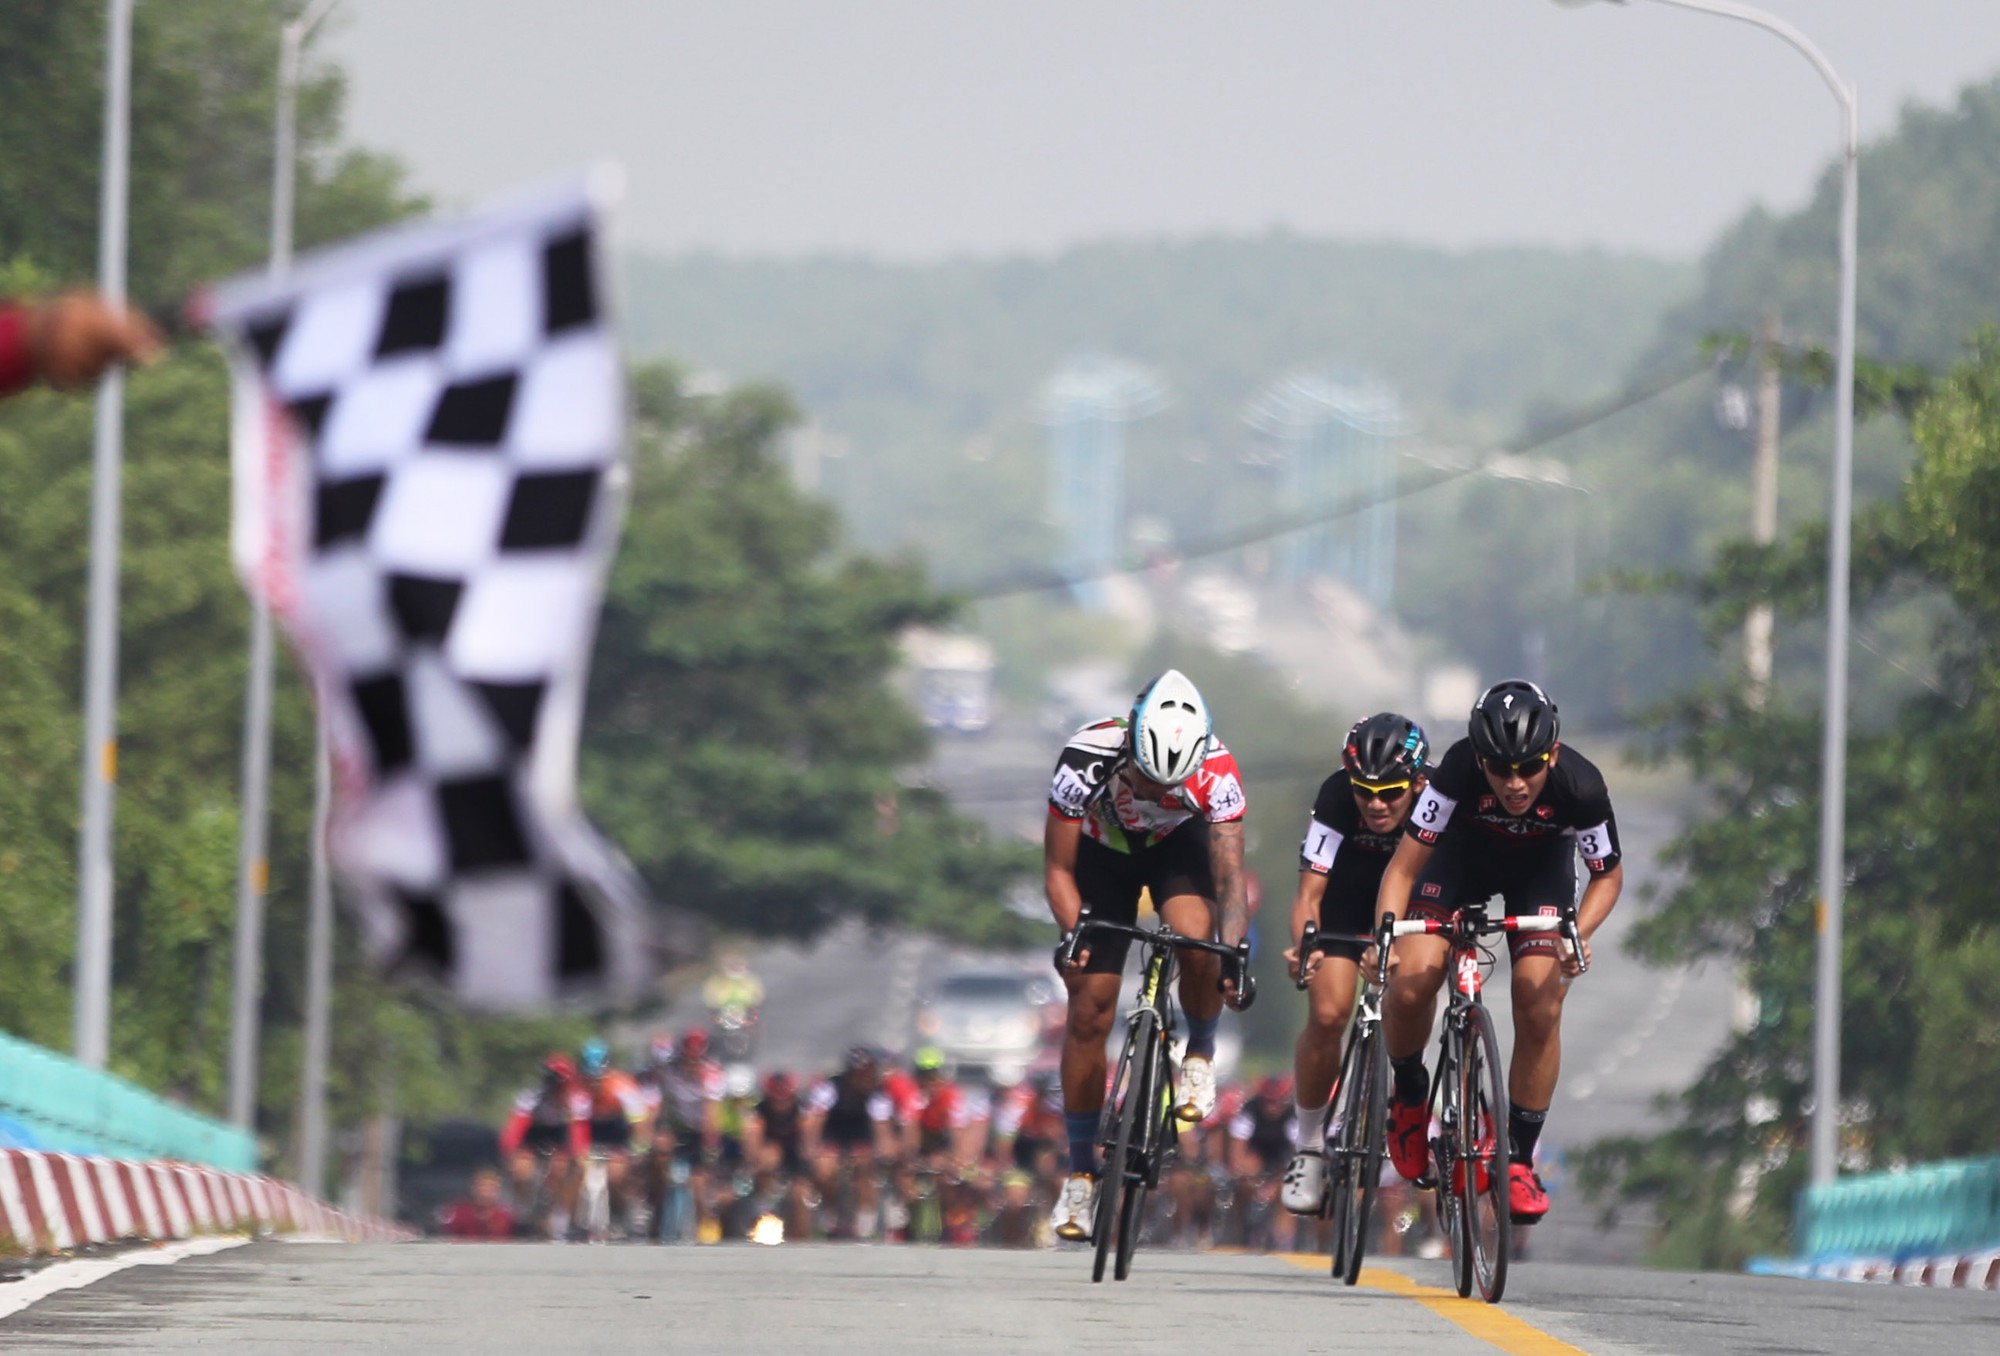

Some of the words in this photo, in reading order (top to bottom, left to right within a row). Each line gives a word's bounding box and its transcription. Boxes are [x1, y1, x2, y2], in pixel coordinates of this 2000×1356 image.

[1054, 773, 1083, 804] 143
[1422, 799, 1440, 824] 3
[1313, 833, 1328, 857] 1
[1582, 833, 1599, 855] 3
